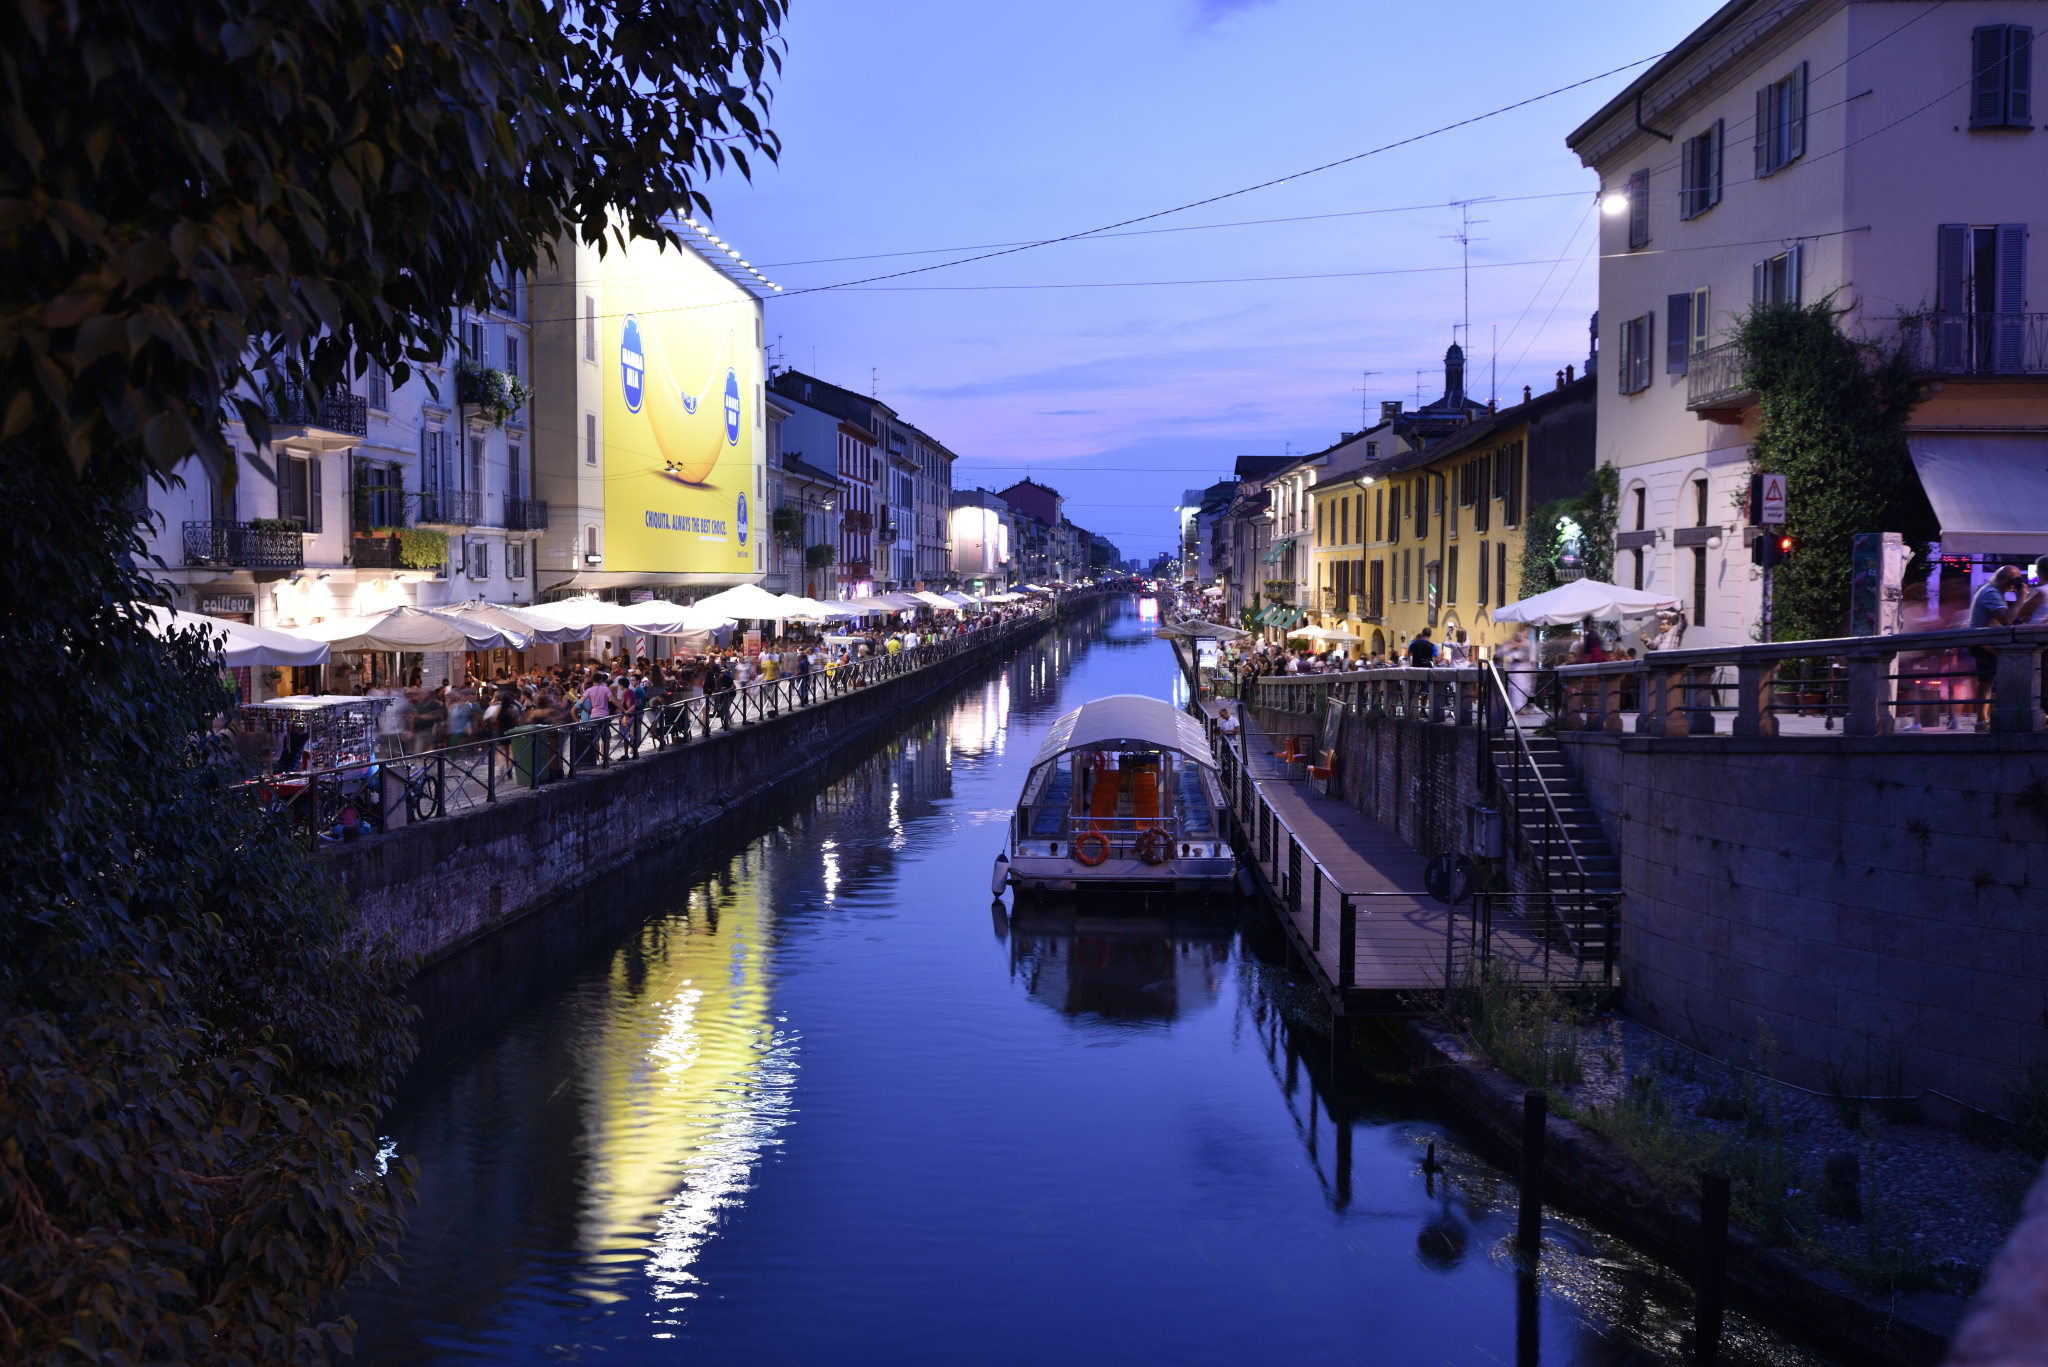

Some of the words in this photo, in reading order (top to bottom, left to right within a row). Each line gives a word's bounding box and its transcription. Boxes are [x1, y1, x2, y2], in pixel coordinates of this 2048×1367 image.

[627, 367, 639, 389] MIA
[645, 510, 670, 530] CHIQUITA.
[672, 514, 690, 532] ALWAYS
[692, 517, 700, 533] THE
[701, 518, 710, 534] BEST
[712, 520, 727, 535] CHOICE.
[202, 596, 249, 612] coiffeur
